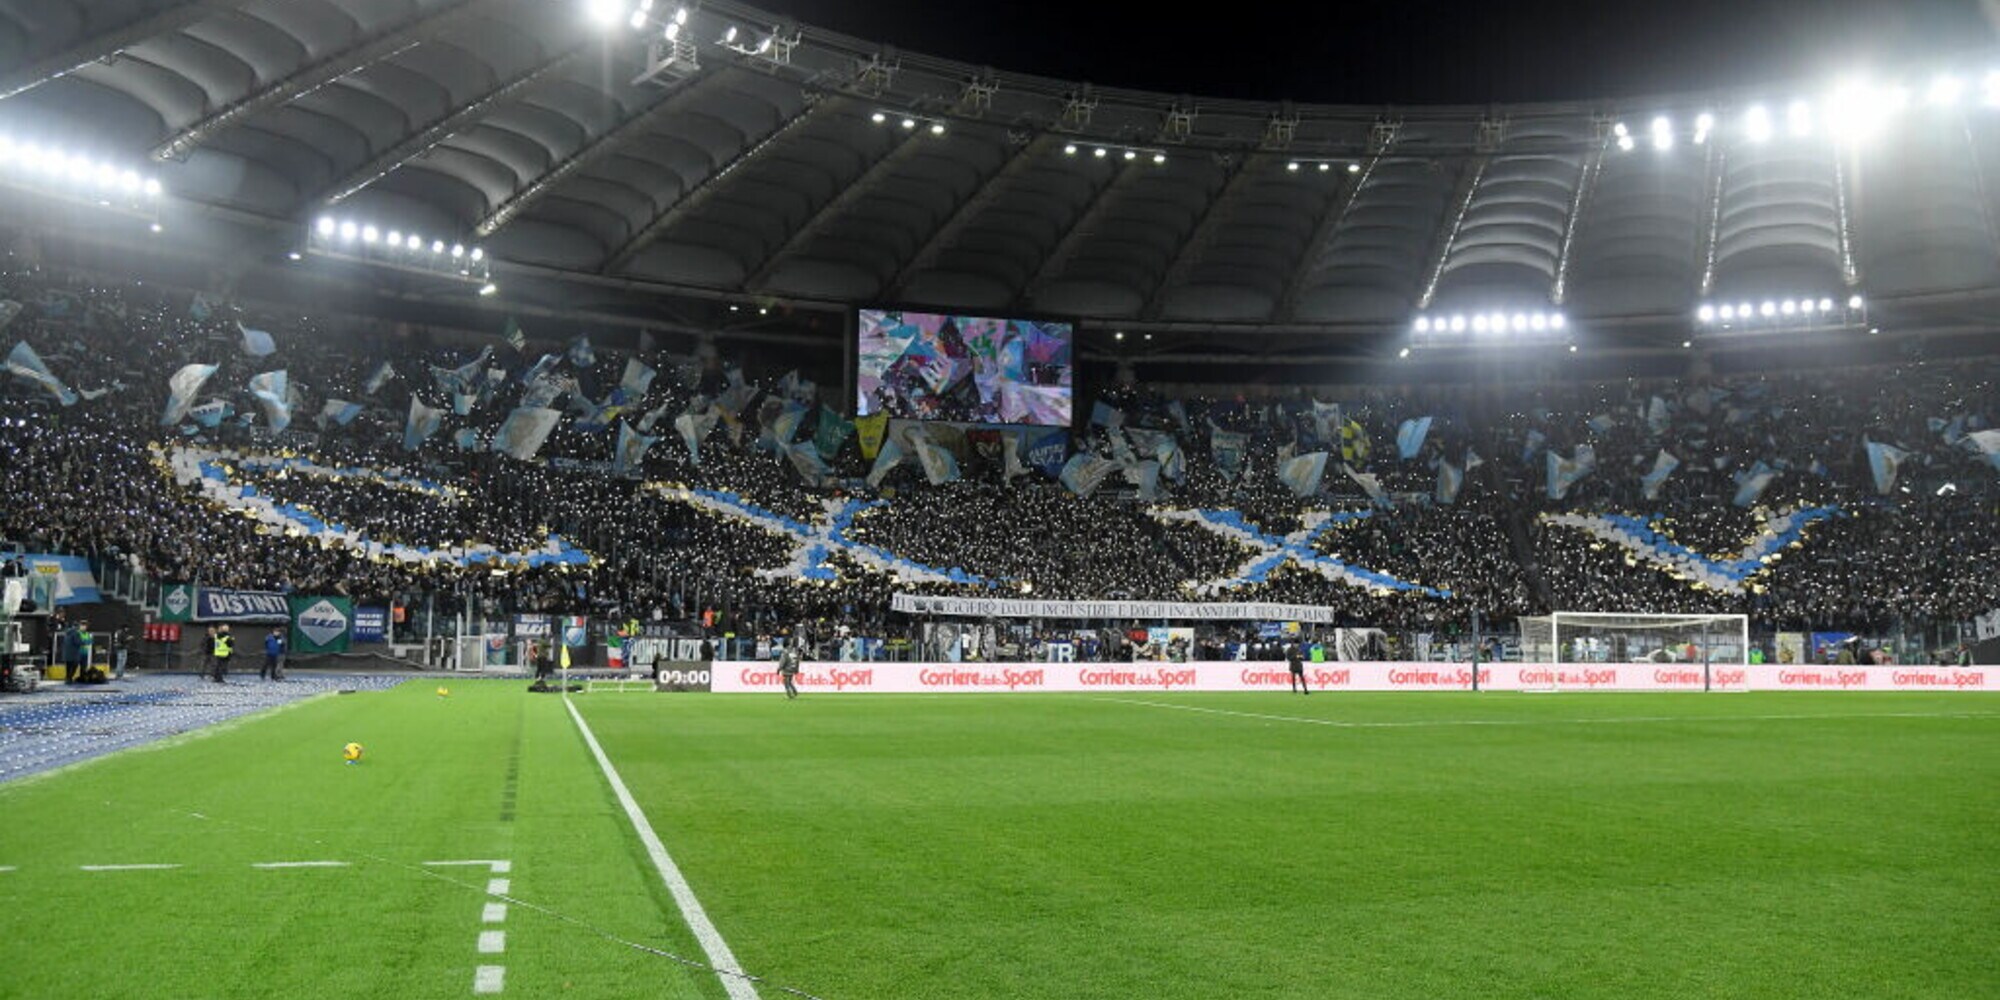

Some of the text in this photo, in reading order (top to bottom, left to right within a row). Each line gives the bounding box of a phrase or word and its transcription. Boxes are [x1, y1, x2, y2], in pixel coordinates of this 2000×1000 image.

[208, 592, 289, 614] DISTINTI
[919, 668, 980, 686] Corriere
[1002, 668, 1044, 690] Sport
[1079, 669, 1136, 686] Corriere
[1157, 669, 1197, 689] Sport
[1388, 670, 1438, 686] Corriere
[1779, 671, 1822, 686] Corriere
[1892, 671, 1937, 687] Corriere
